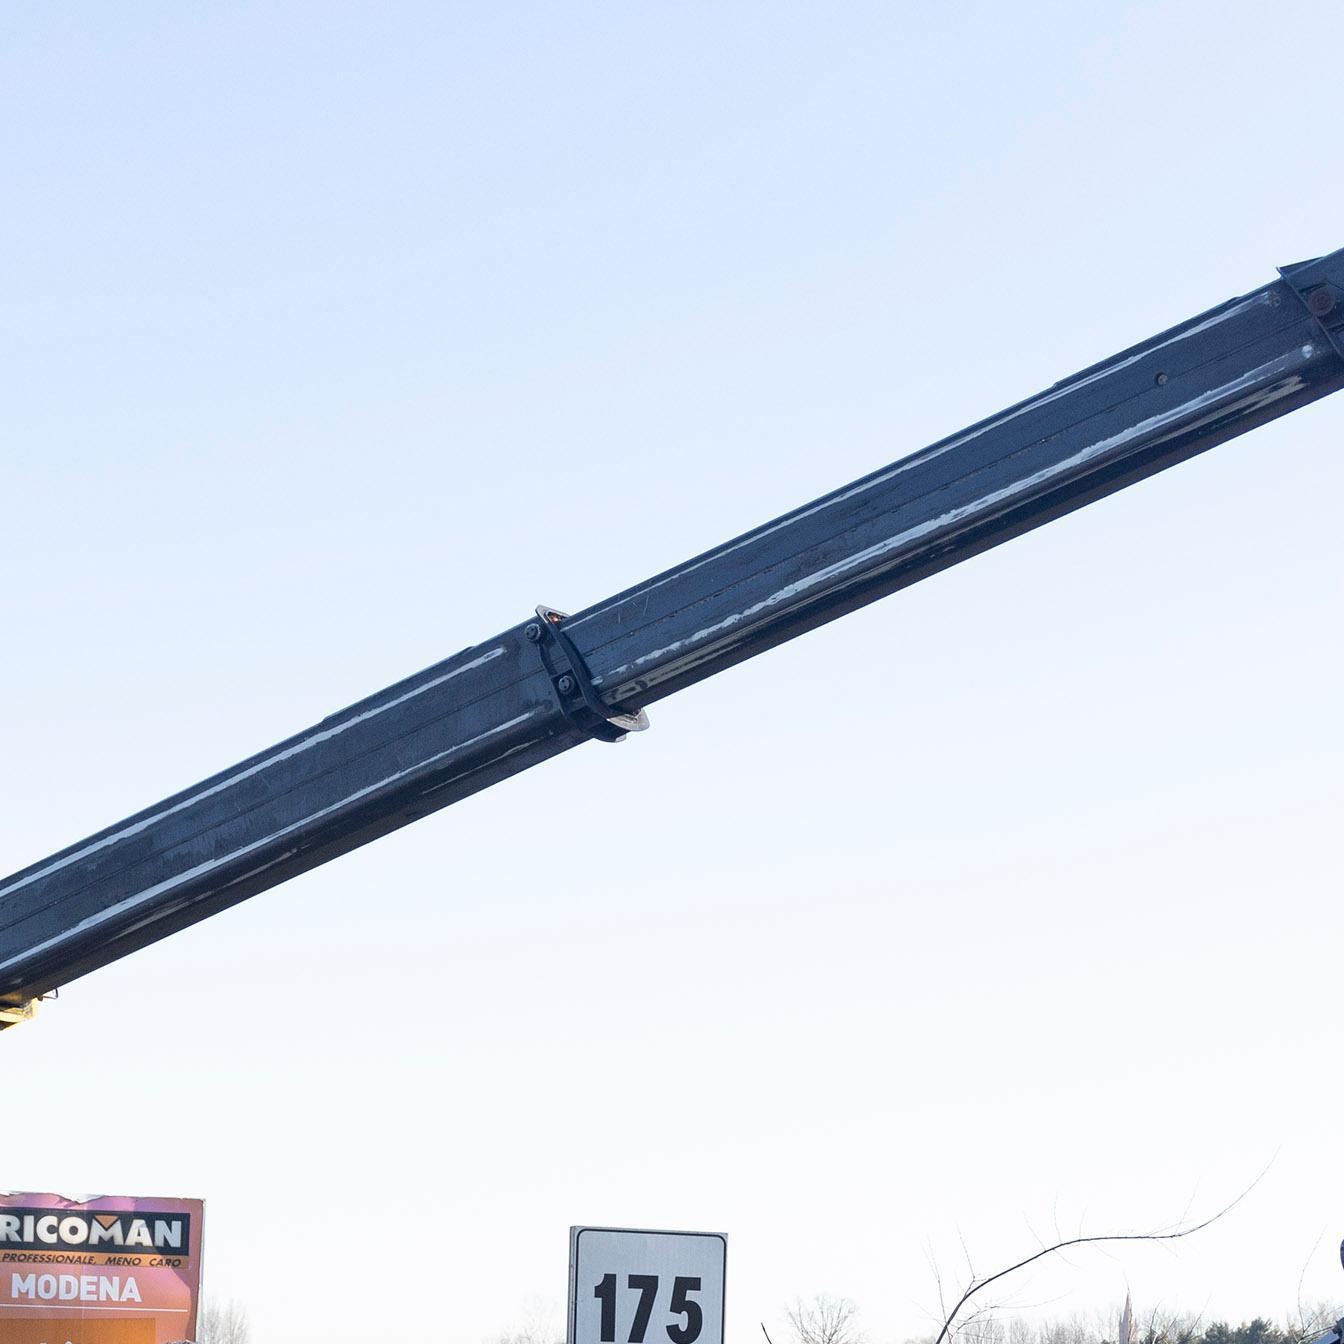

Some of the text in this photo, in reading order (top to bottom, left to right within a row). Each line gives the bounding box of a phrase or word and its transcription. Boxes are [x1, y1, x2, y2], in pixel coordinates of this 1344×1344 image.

[2, 1253, 96, 1265] PROFESSIONALE,
[105, 1256, 142, 1267] MENO
[149, 1257, 182, 1268] CARO
[11, 1272, 142, 1303] MODENA
